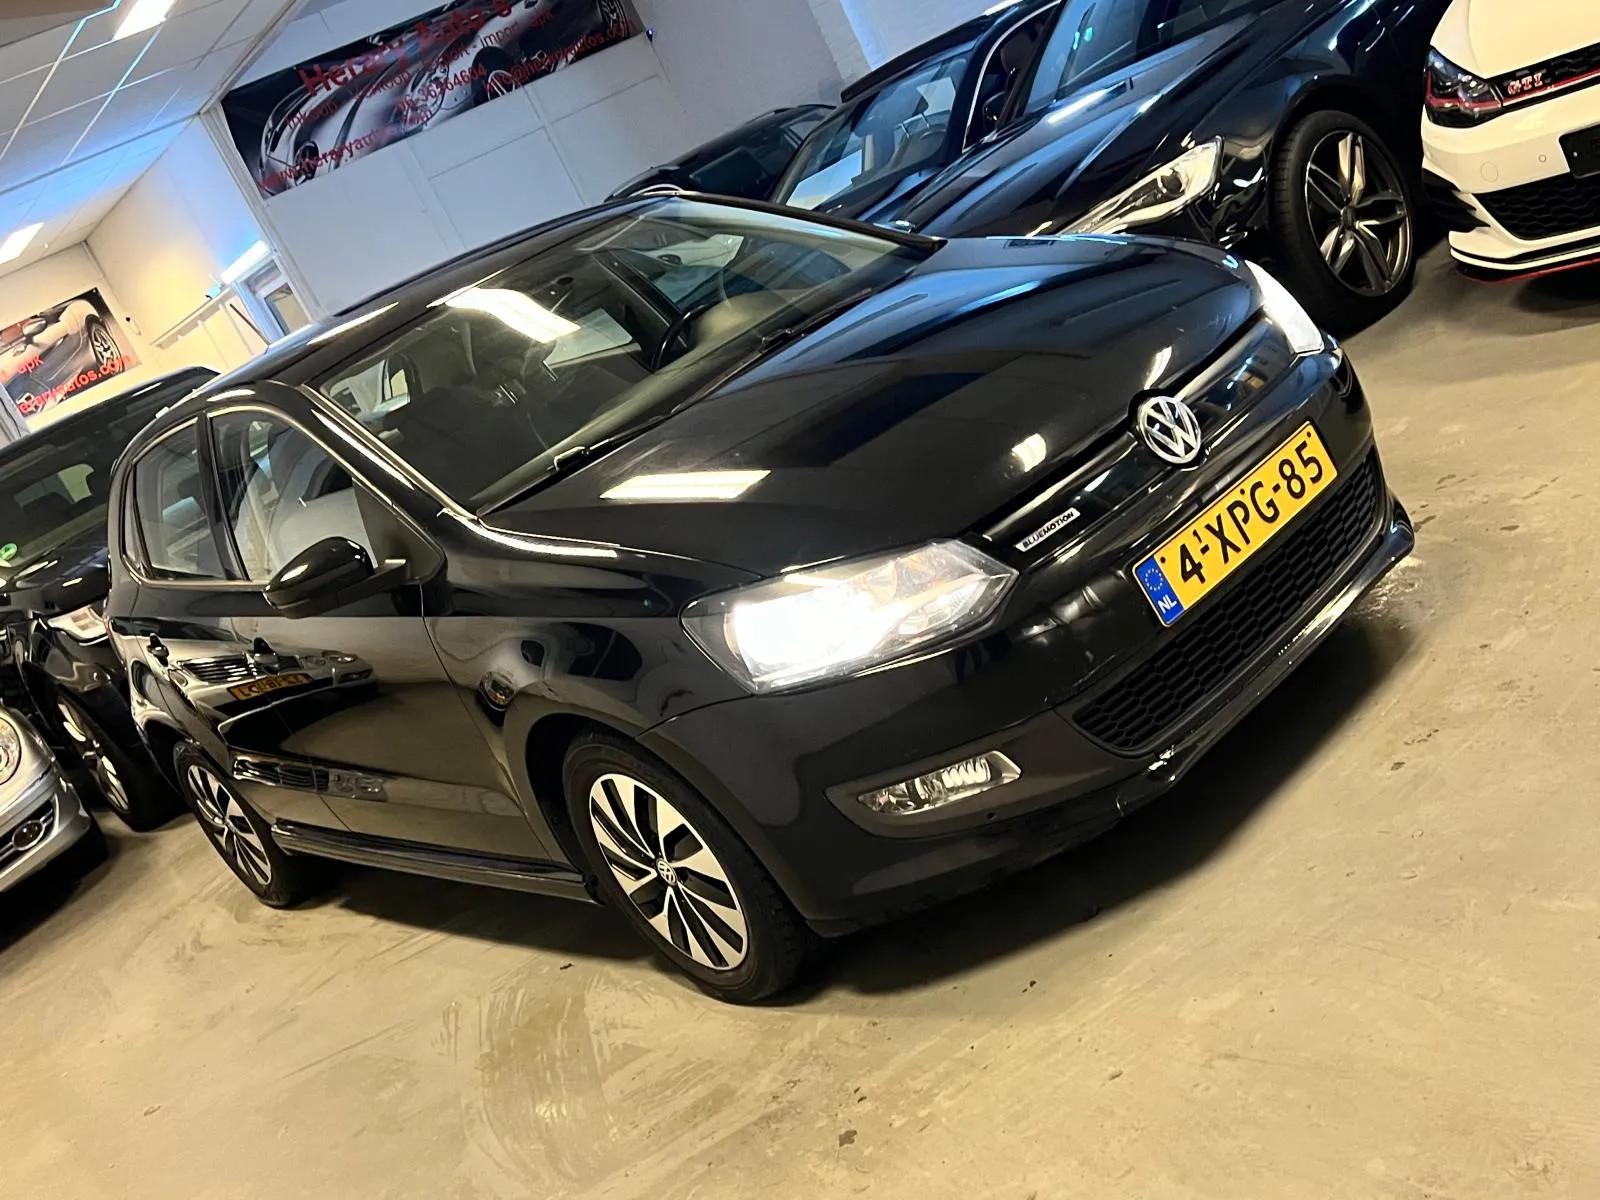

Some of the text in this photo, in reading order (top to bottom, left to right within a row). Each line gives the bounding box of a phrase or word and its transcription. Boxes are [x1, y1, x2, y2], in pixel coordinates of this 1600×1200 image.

[1507, 72, 1543, 95] GTI
[1179, 440, 1323, 584] 4-XPG-85
[1022, 511, 1074, 548] BLUEMOTION
[1157, 596, 1178, 614] NL
